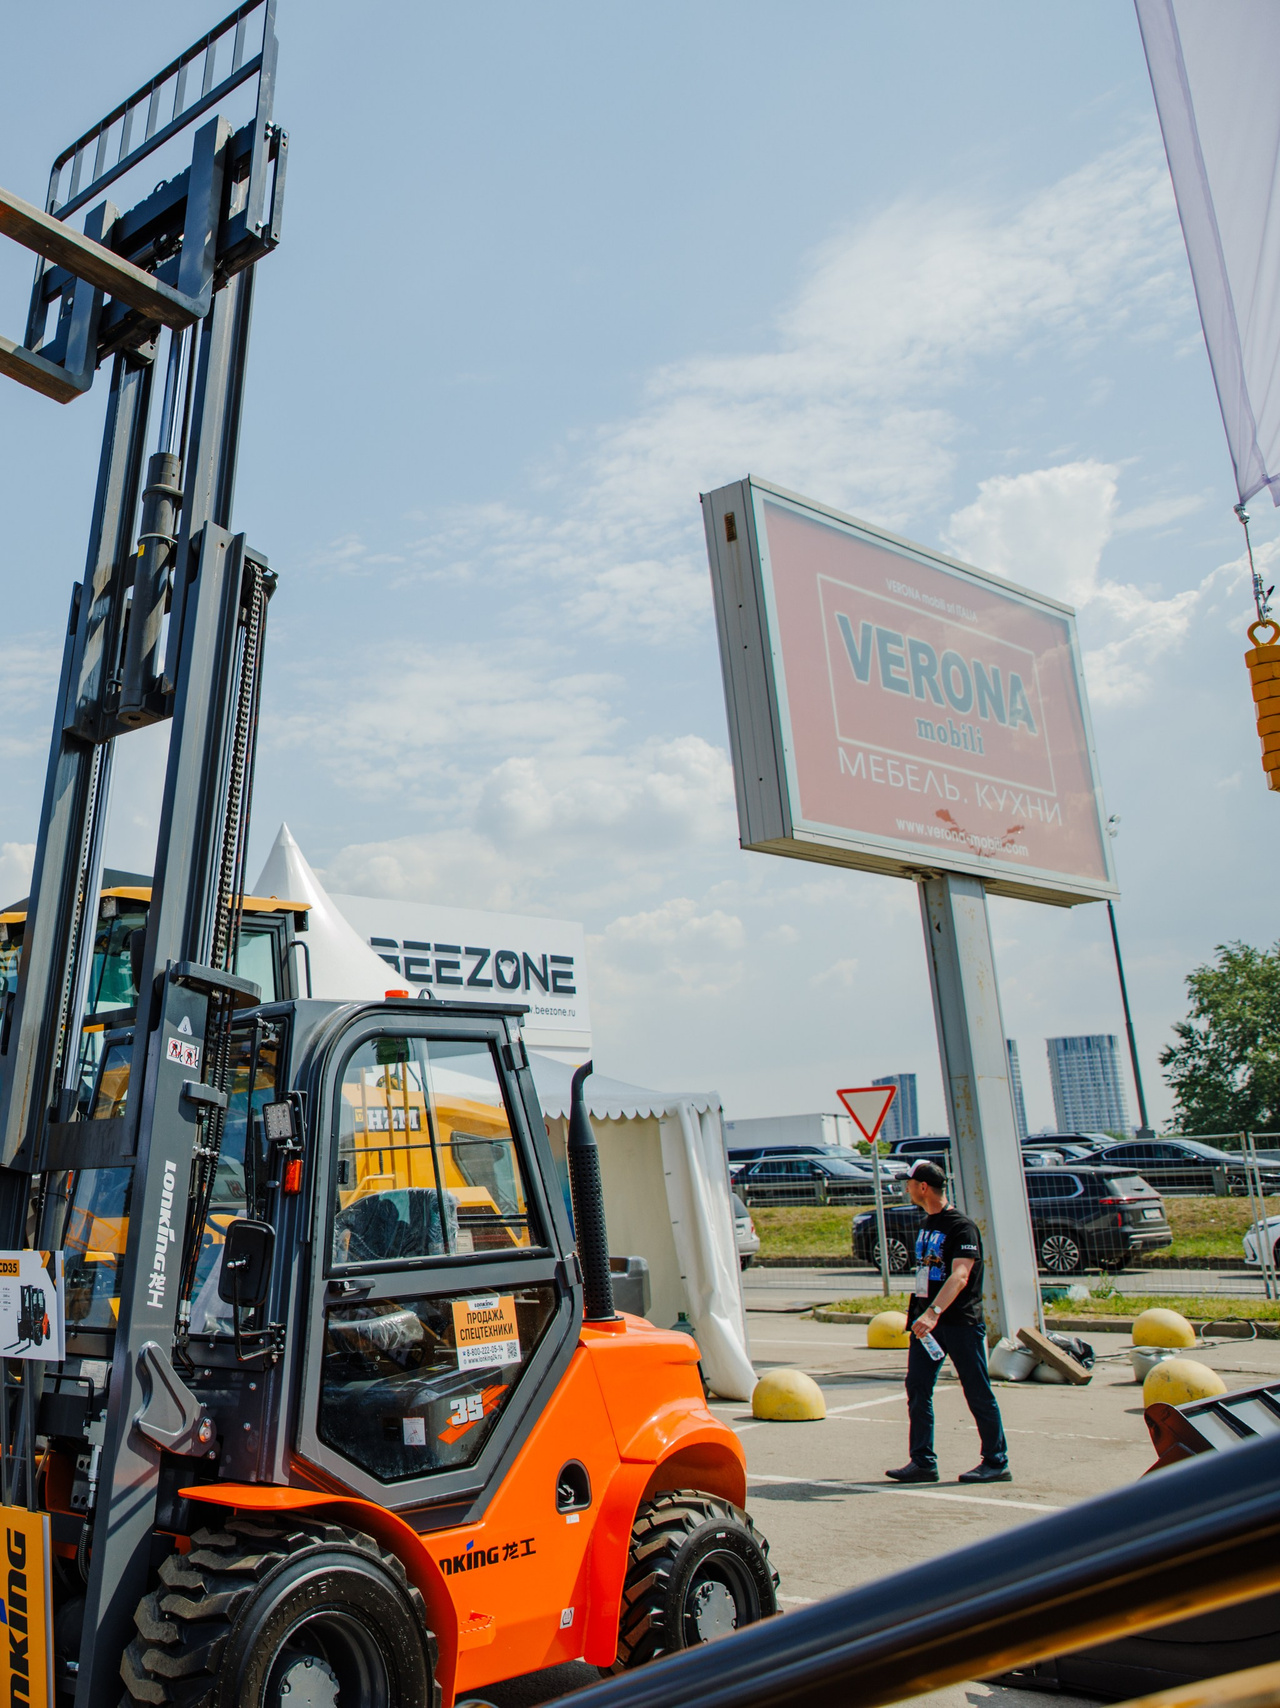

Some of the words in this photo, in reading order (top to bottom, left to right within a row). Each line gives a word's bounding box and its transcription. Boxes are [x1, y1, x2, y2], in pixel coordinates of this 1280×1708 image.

[834, 611, 1039, 737] VERONA
[915, 717, 985, 756] mobili
[975, 782, 1063, 827] КУХНИ
[367, 1109, 419, 1130] HZM
[466, 1308, 504, 1325] ПРОДАЖА
[459, 1323, 514, 1341] СПЕЦТЕХНИКИ
[450, 1393, 484, 1426] 35
[503, 1537, 537, 1561] 龙工
